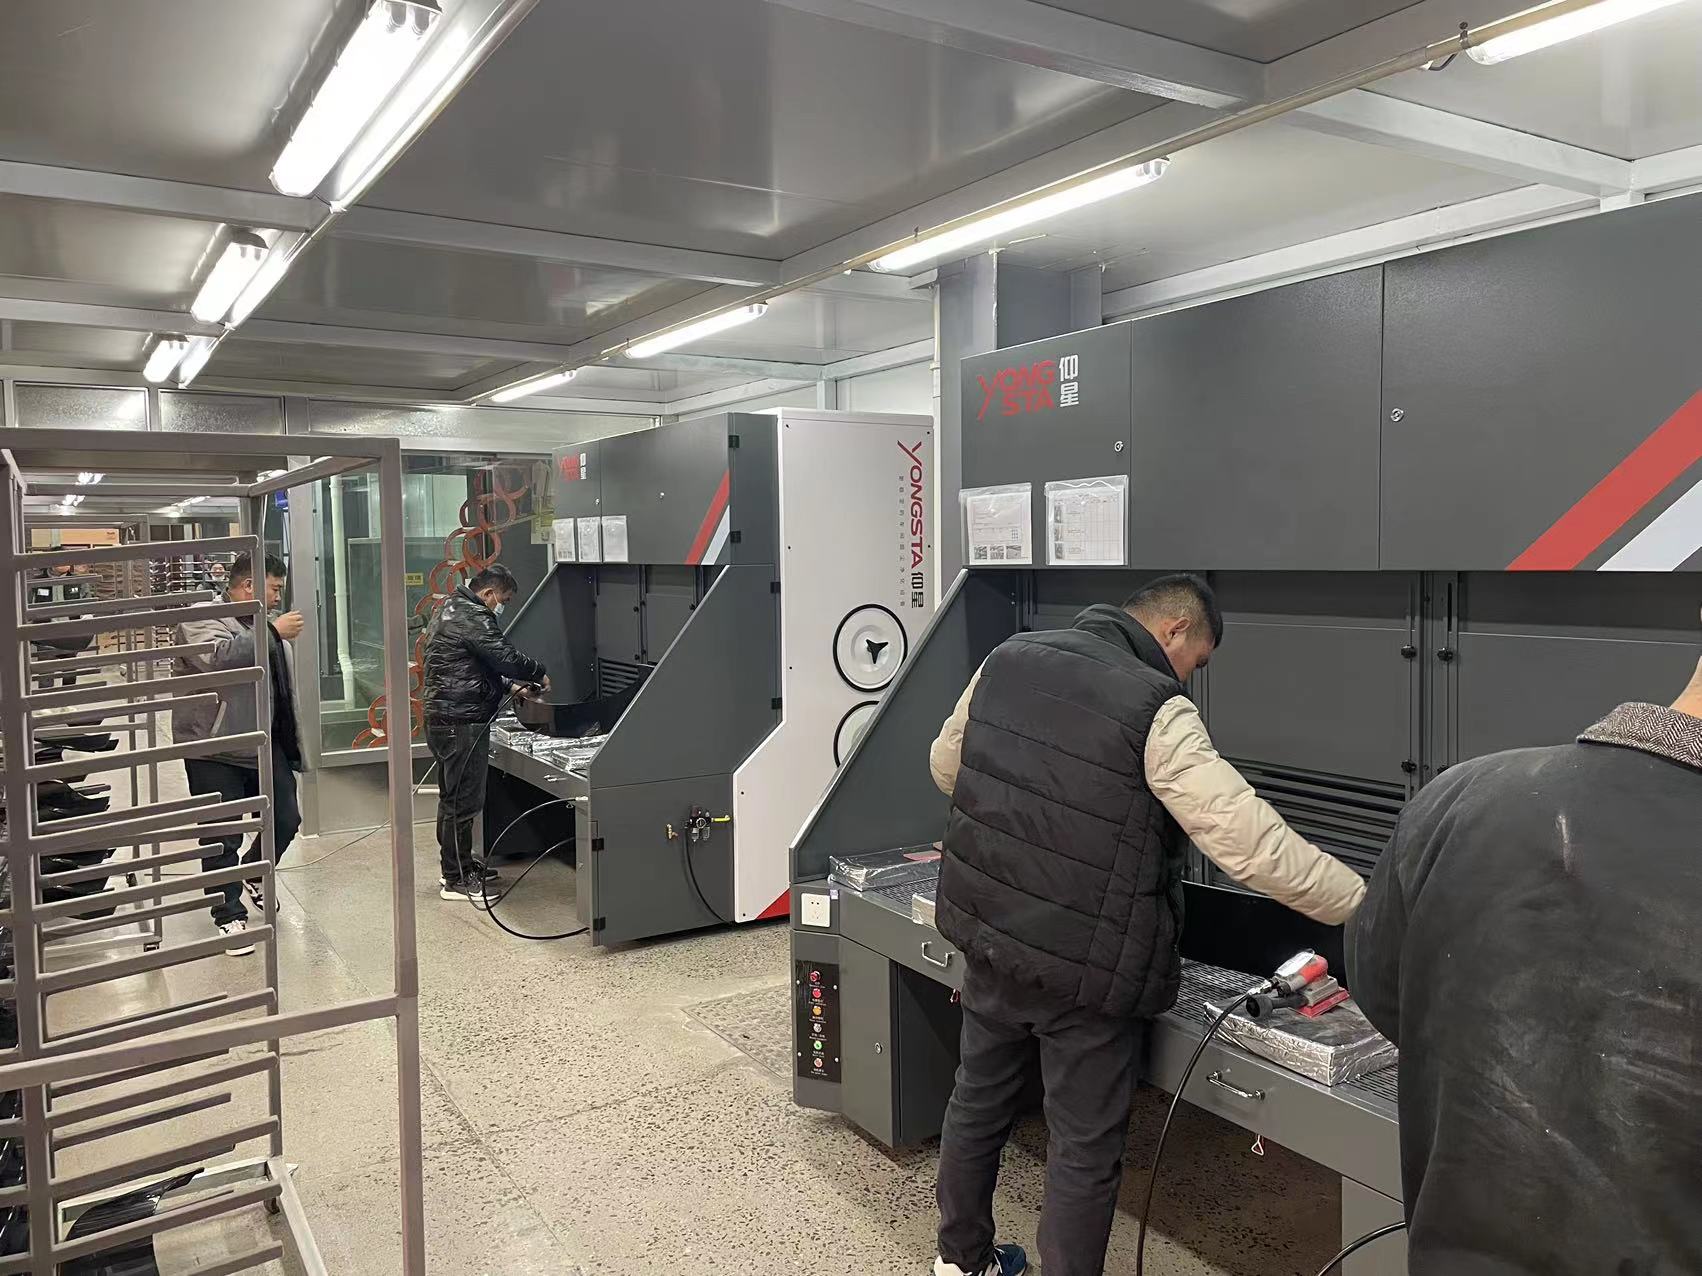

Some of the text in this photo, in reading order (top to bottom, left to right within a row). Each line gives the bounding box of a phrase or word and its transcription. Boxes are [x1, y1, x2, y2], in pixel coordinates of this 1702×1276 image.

[977, 360, 1057, 422] YONG
[1001, 388, 1055, 417] STA
[1059, 354, 1079, 408] 仰星
[897, 440, 924, 569] YONGSTA
[911, 571, 924, 608] 仰星
